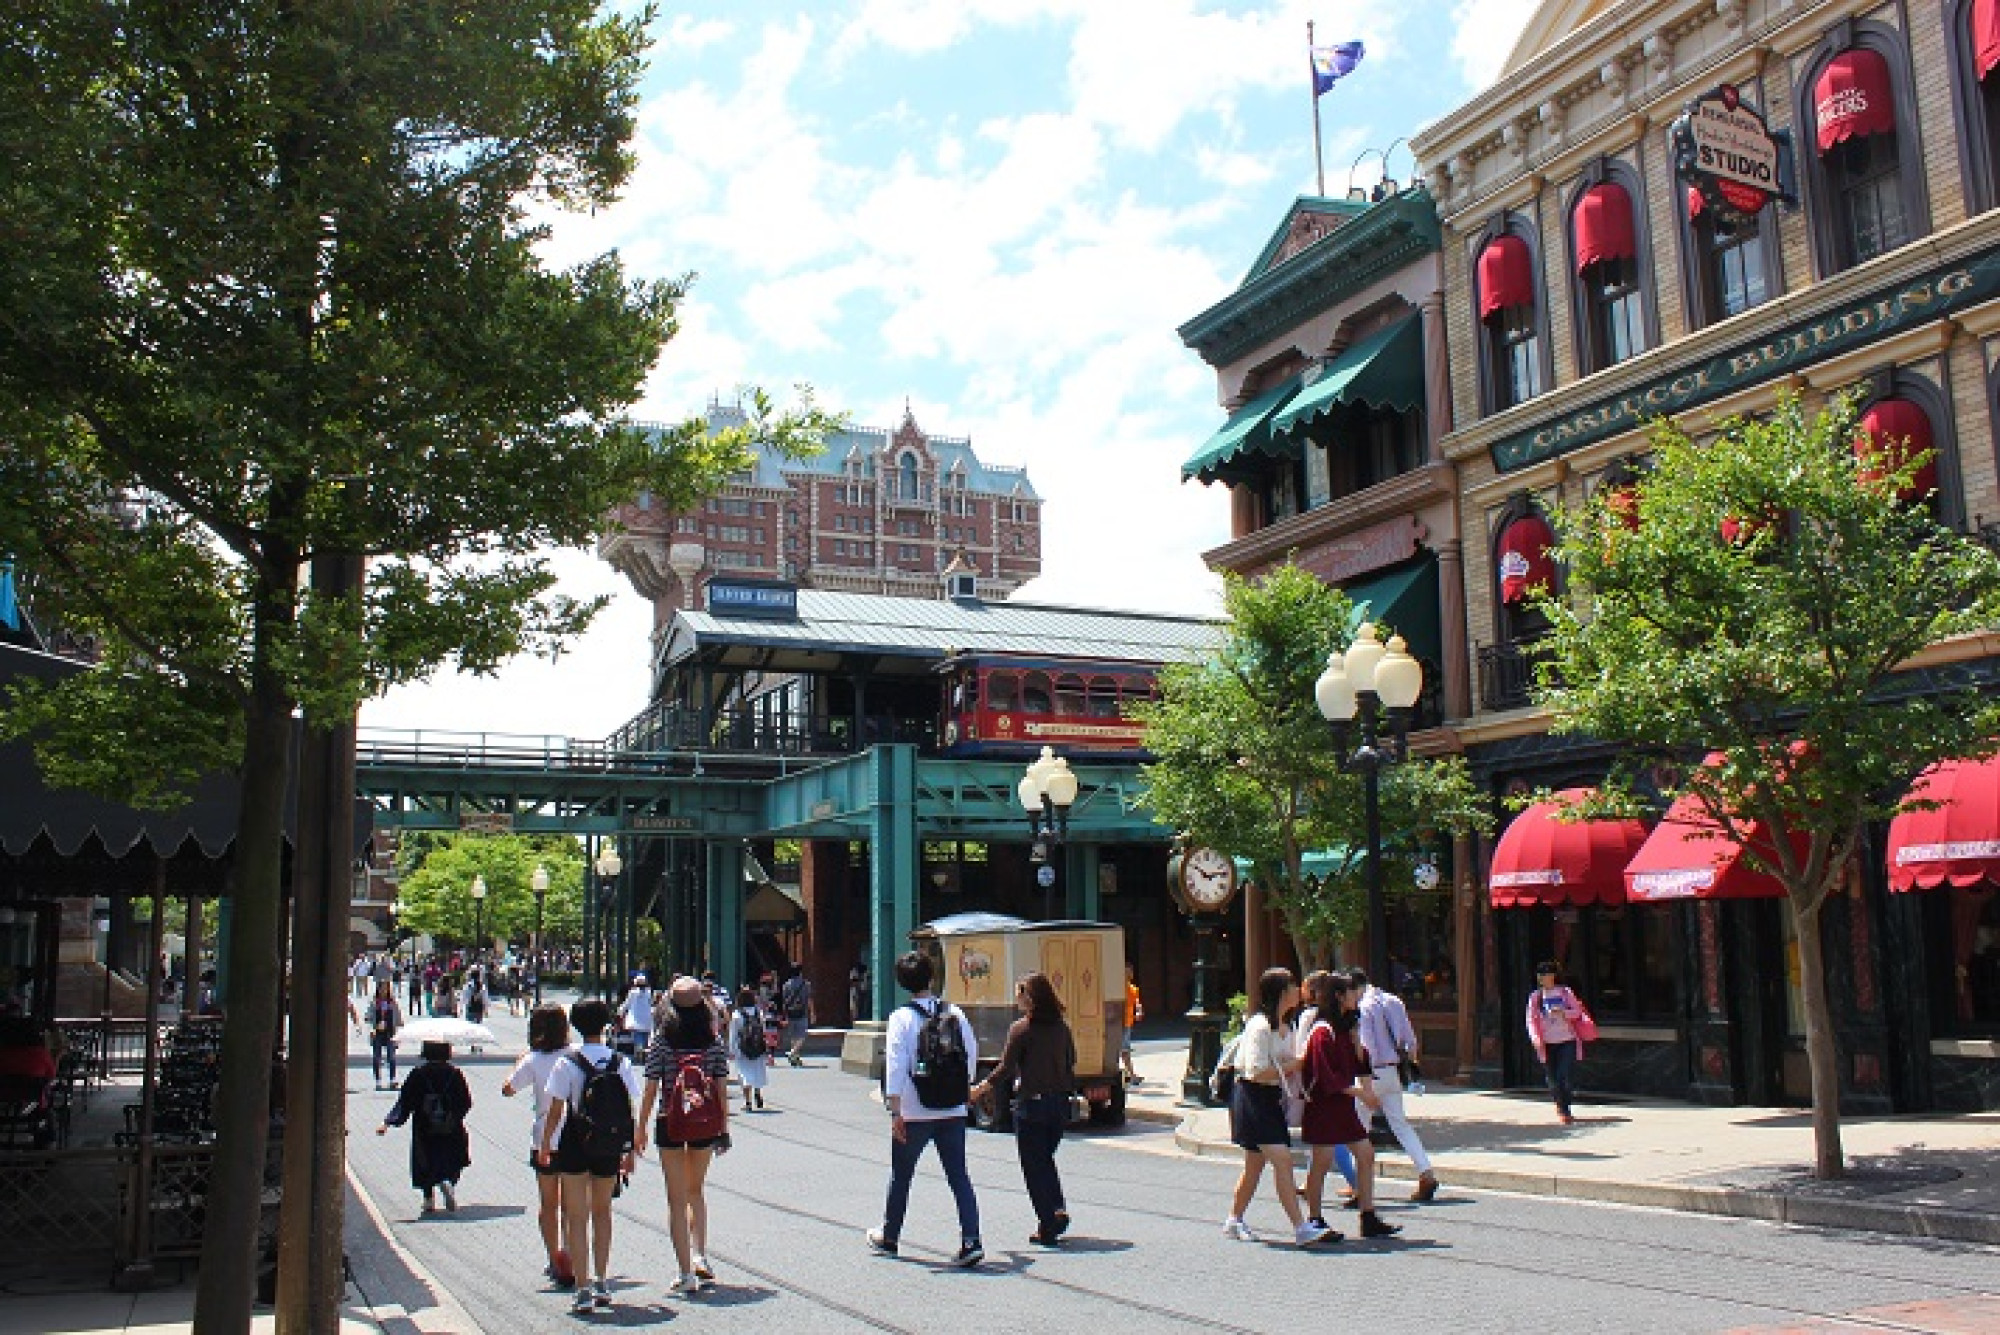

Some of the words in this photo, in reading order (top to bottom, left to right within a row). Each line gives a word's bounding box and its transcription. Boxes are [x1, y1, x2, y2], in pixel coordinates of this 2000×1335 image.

[1699, 144, 1771, 183] STUDIO
[1533, 368, 1710, 447] CARLUCCI
[1727, 268, 1974, 378] BUILDING
